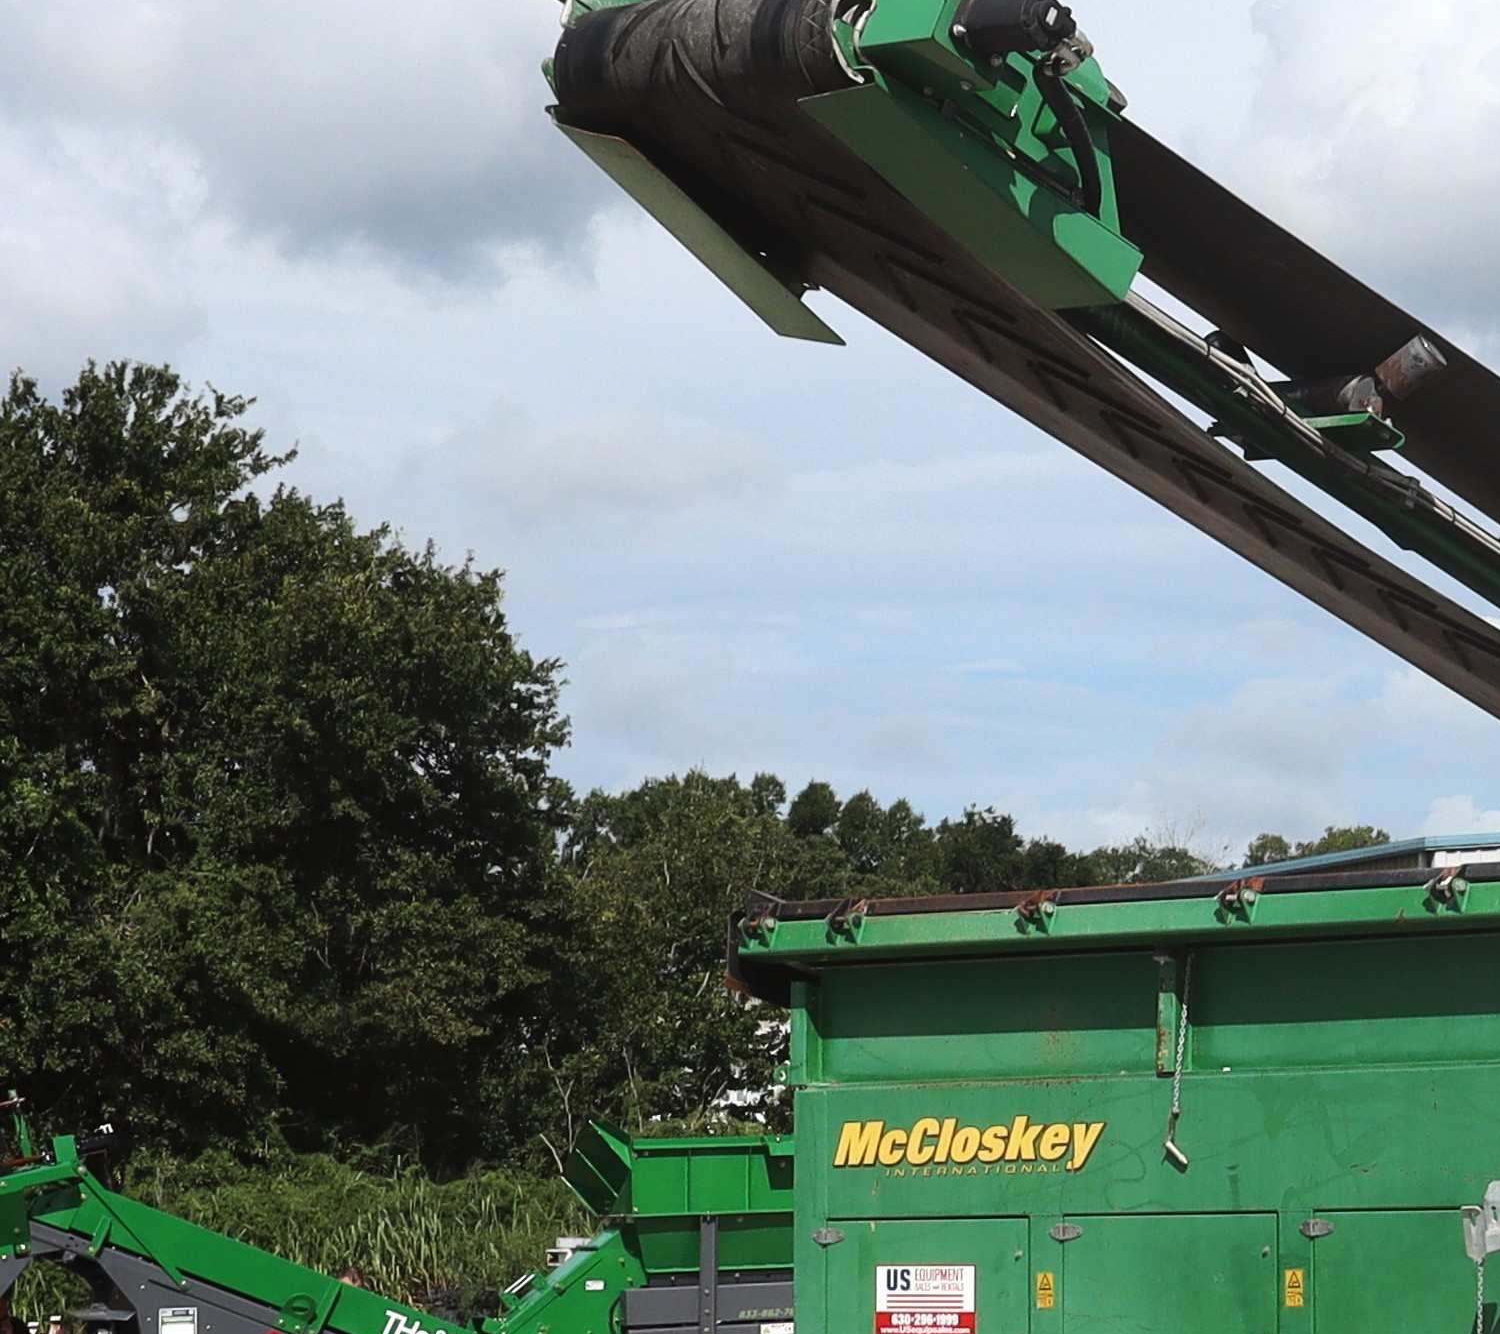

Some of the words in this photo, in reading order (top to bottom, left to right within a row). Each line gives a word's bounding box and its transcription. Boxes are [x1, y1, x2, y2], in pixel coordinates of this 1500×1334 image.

[833, 1115, 1105, 1172] McCloskey
[885, 1163, 1062, 1179] INTERNATIONAL
[886, 1269, 911, 1291] US
[915, 1268, 964, 1281] EQUIPMENT
